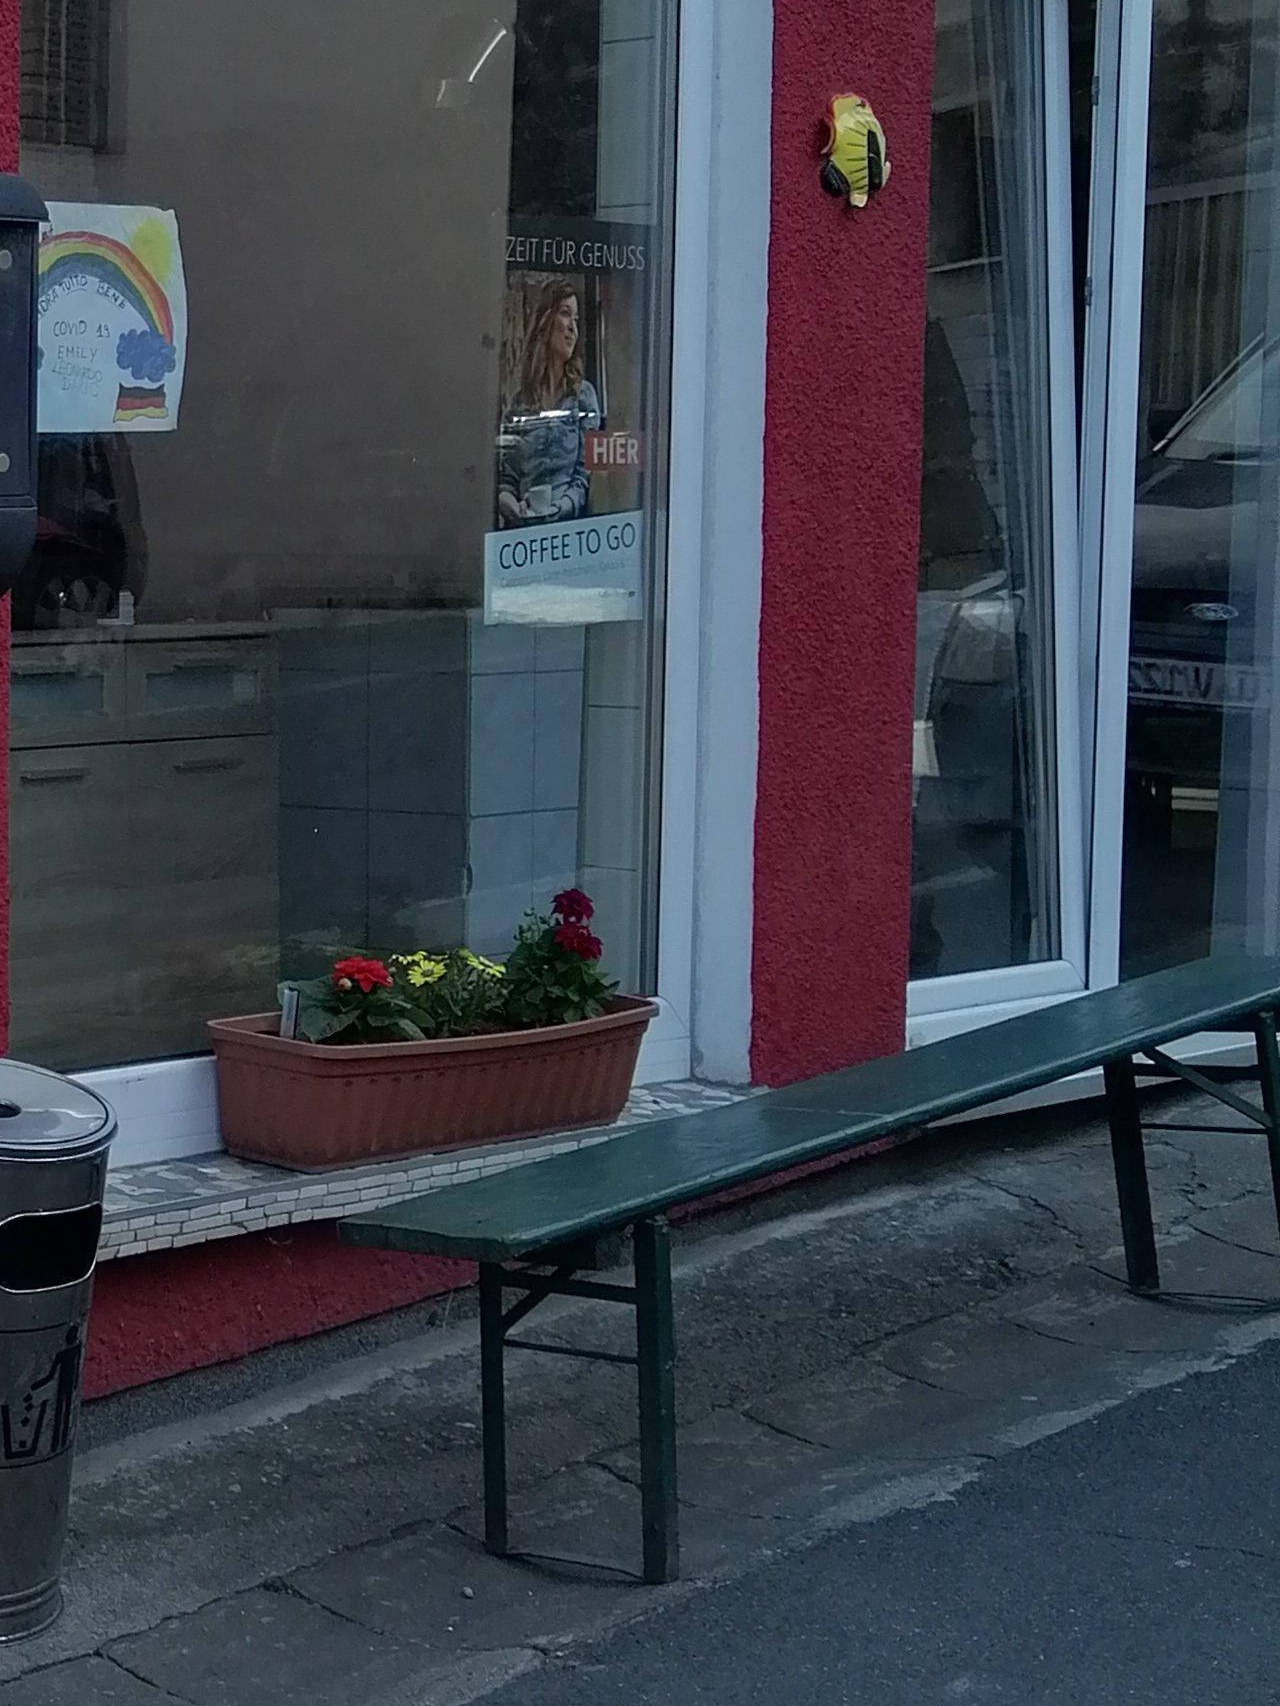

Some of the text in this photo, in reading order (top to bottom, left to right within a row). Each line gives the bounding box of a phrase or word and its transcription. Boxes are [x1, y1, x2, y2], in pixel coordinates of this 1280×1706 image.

[505, 236, 645, 270] ZEIT FÜR GENUSS
[53, 320, 110, 338] COVID 19
[593, 437, 638, 464] HIER
[499, 522, 636, 569] COFFEE TO GO
